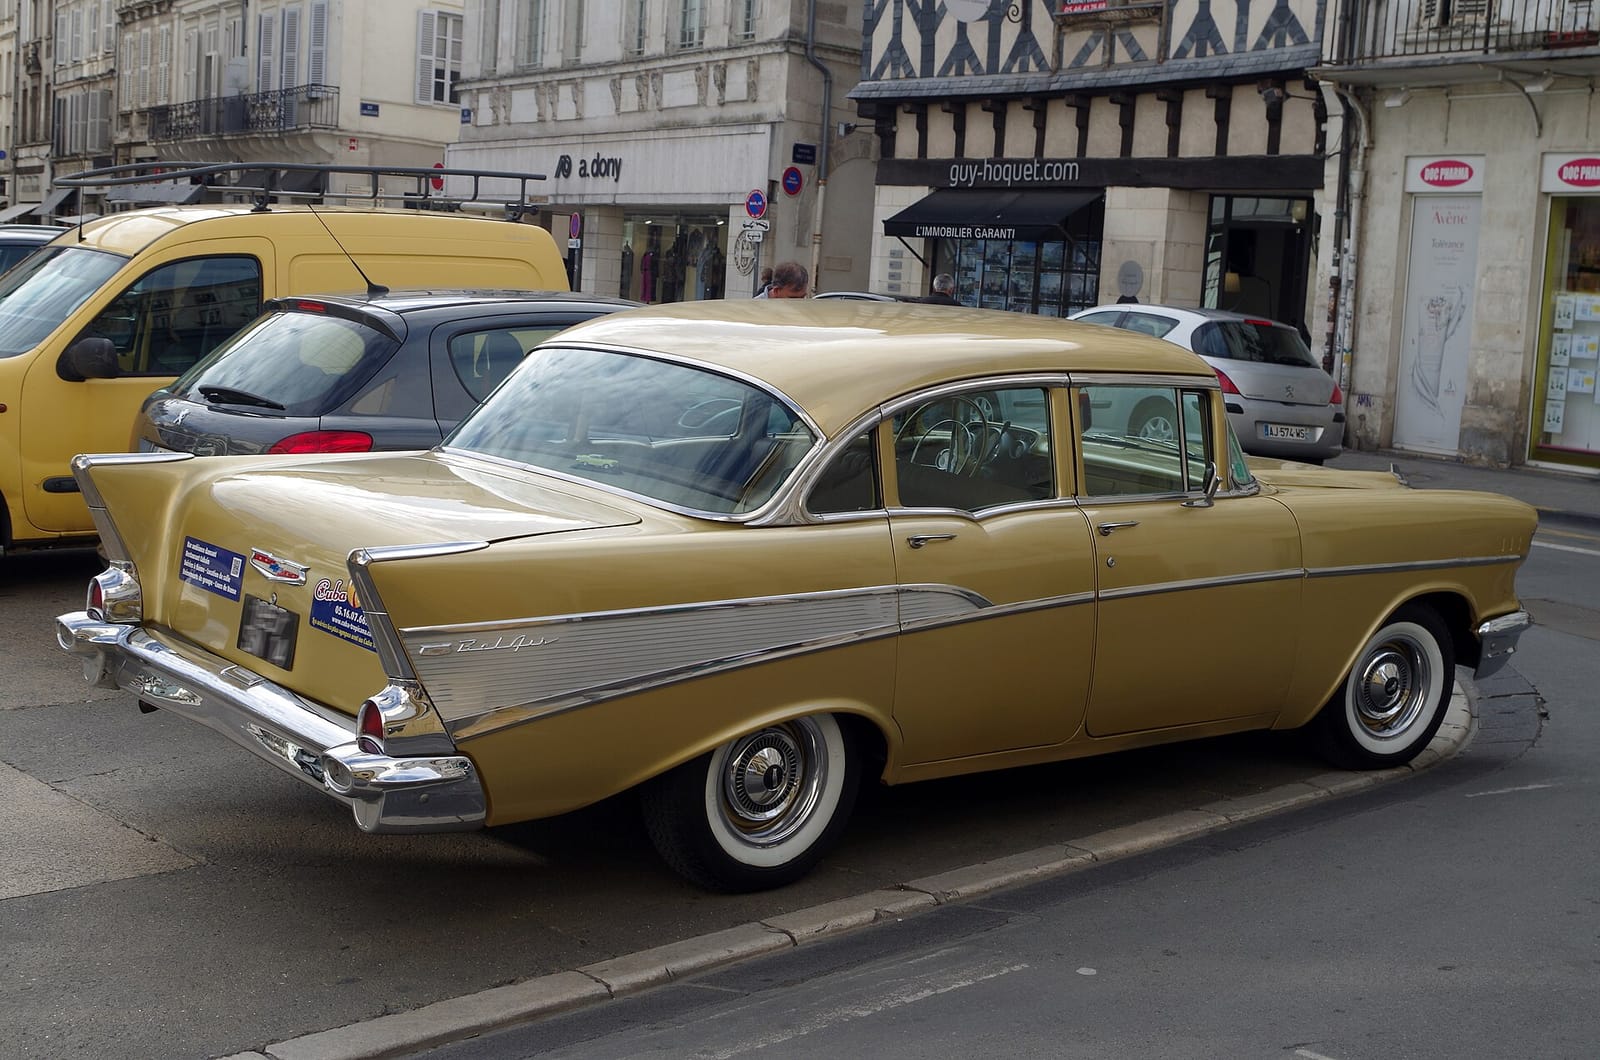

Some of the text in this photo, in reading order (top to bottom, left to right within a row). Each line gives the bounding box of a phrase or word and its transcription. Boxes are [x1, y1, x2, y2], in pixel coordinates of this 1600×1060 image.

[579, 152, 622, 182] a.dony
[950, 158, 1079, 187] guy-hoquet.com
[1424, 167, 1469, 181] DOC PHARMA
[1562, 166, 1580, 180] DOC
[916, 226, 1015, 239] L'IMMOBILIER GARANTI
[314, 578, 348, 602] Cuba
[334, 605, 369, 625] 05.16.07.66.
